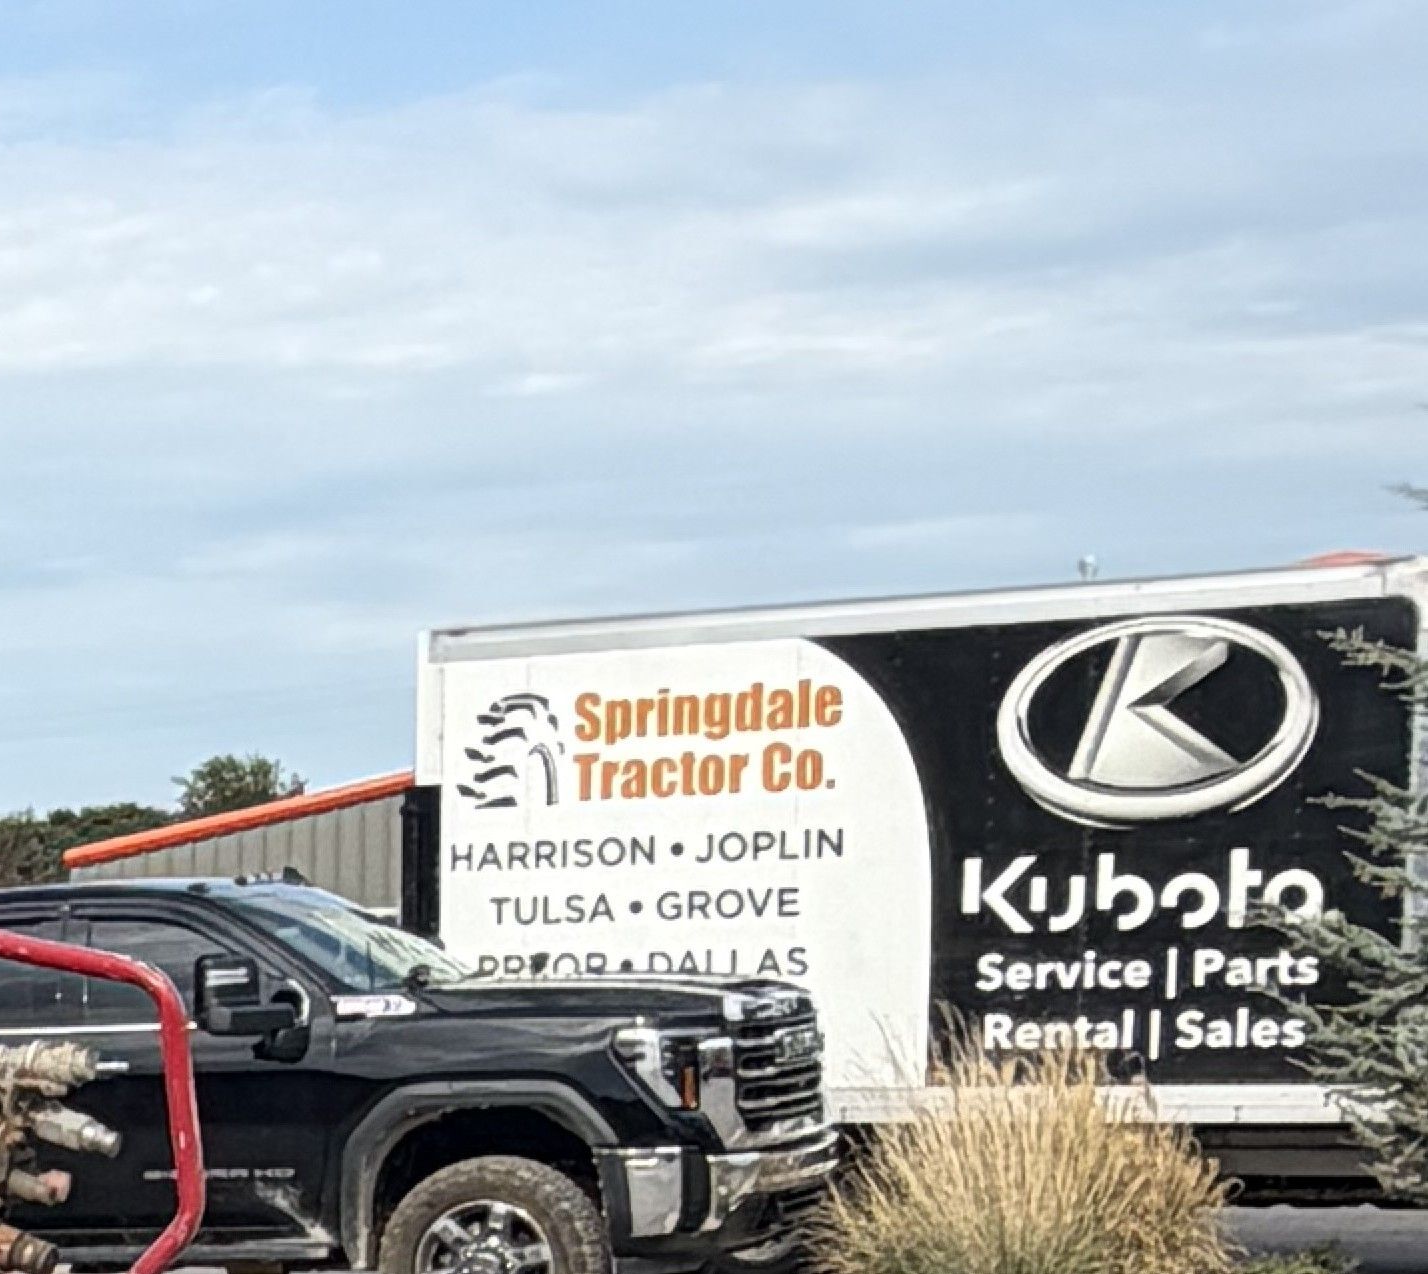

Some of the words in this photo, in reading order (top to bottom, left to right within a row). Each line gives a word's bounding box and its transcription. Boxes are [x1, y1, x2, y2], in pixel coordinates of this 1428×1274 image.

[573, 678, 844, 746] Springdale
[573, 751, 750, 802] Tractor
[761, 741, 837, 793] Co.
[449, 835, 656, 872] HARRISON
[695, 828, 844, 863] JOPLIN
[489, 892, 616, 926] TULSA
[655, 887, 801, 921] GROVE
[959, 846, 1325, 934] Kubota
[647, 947, 809, 977] DALLAS
[974, 950, 1152, 992] Service
[1192, 948, 1321, 990] Parts
[983, 1007, 1135, 1051] Rental
[1174, 1006, 1307, 1049] Sales
